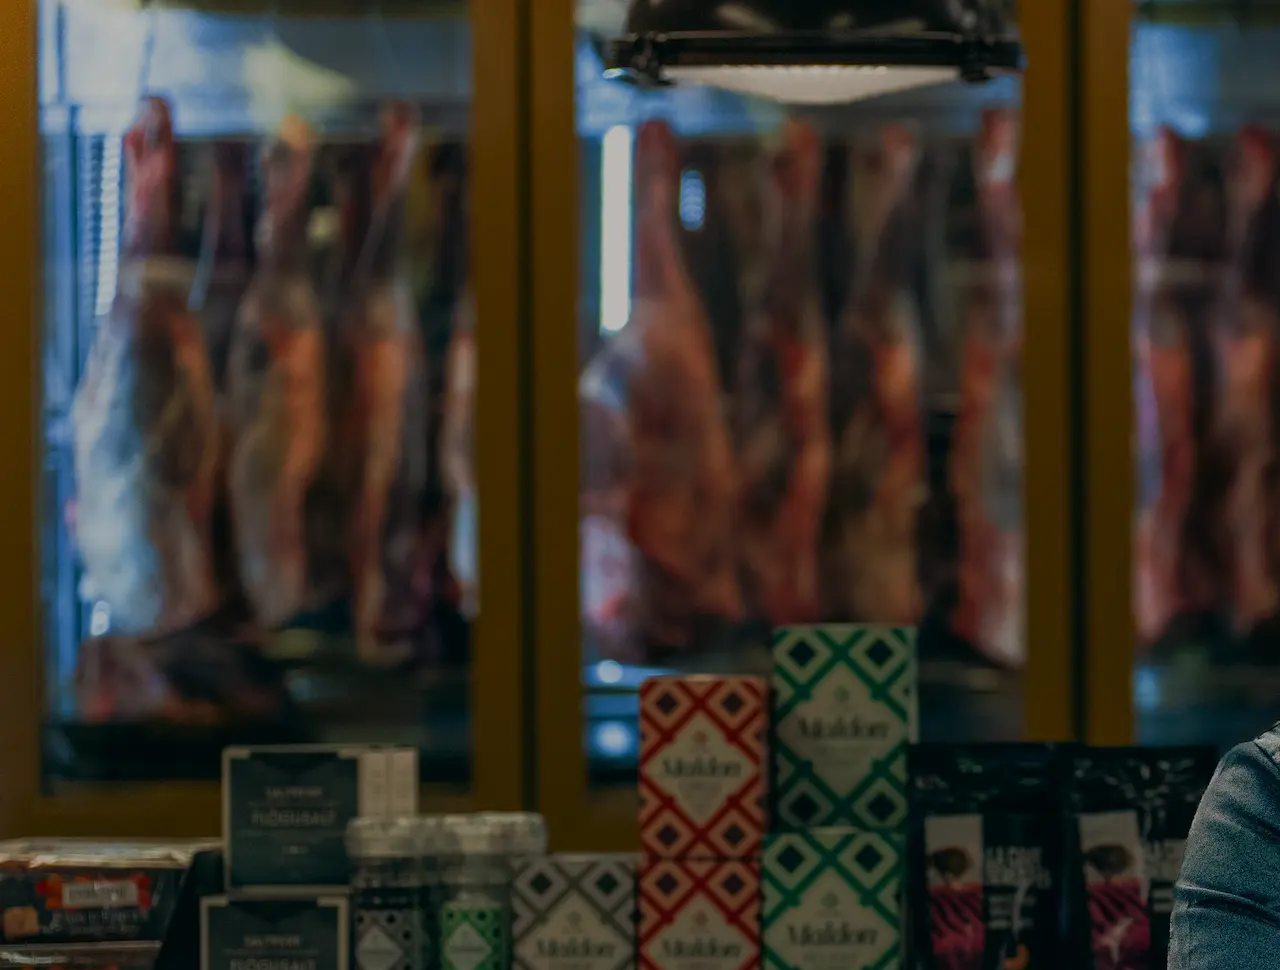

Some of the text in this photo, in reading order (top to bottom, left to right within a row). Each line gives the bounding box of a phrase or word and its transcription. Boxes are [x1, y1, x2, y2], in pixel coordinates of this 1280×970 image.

[797, 714, 890, 740] Maldon
[660, 754, 742, 778] Maldon
[786, 920, 878, 946] Maldon
[662, 936, 742, 958] Maldon
